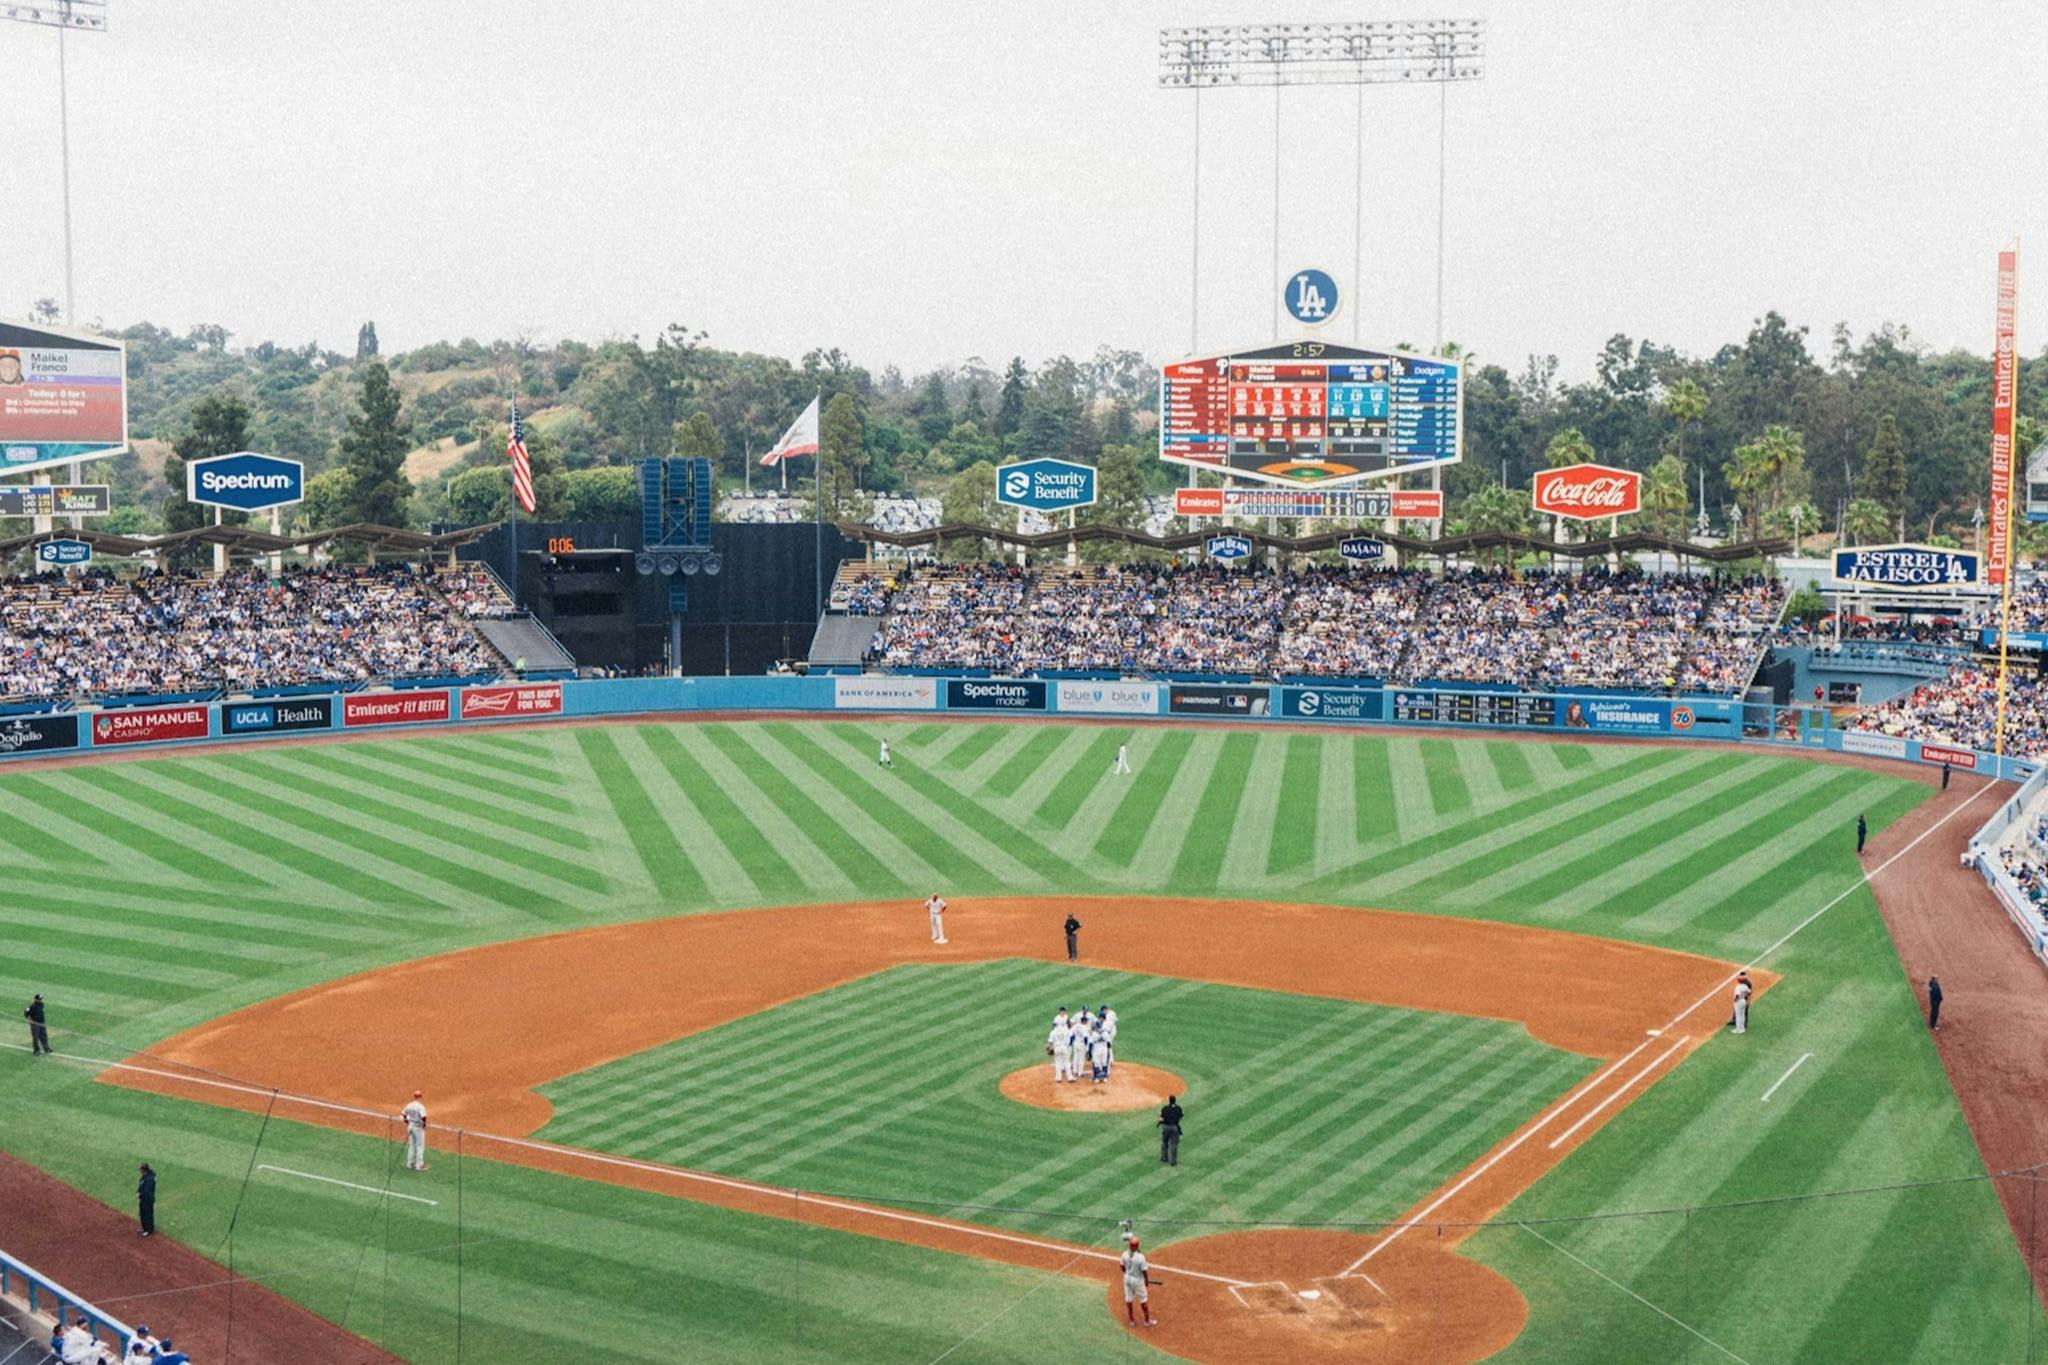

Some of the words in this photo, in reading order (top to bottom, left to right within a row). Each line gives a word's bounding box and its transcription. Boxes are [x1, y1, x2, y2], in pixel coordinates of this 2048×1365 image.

[1296, 275, 1326, 317] LA
[1293, 344, 1325, 357] 2:57
[31, 353, 68, 362] Maikel
[31, 362, 68, 372] Franco
[1414, 367, 1446, 376] Dodgers
[1995, 336, 2012, 408] Emirates
[1993, 433, 2010, 472] BETTER
[202, 471, 289, 493] Spectrum
[1034, 472, 1086, 488] Security
[1992, 473, 2008, 492] FLY
[1035, 486, 1079, 499] Benefit
[1542, 477, 1630, 507] Coca-Cola
[1180, 497, 1220, 507] Emirates
[1381, 501, 1389, 515] 2
[1990, 498, 2007, 570] Emirates
[1343, 543, 1382, 555] DASANI
[1845, 566, 1940, 583] JALISCO
[518, 690, 535, 699] THIS
[536, 689, 560, 698] BUD'S
[963, 683, 1027, 699] Spectrum
[1063, 689, 1090, 701] blue
[1112, 690, 1139, 702] blue
[518, 700, 533, 710] FOR
[995, 698, 1026, 706] mobile
[1323, 693, 1367, 707] Security
[347, 703, 400, 717] Emirates
[403, 701, 417, 713] FLY
[418, 700, 446, 712] BETTER
[1323, 706, 1360, 717] Benefit
[113, 716, 142, 729] SAN
[146, 711, 203, 727] MANUEL
[236, 712, 268, 724] UCLA
[277, 707, 323, 723] Health
[1596, 711, 1660, 724] INSURANCE
[1674, 712, 1690, 724] 76
[113, 728, 150, 738] CASINO
